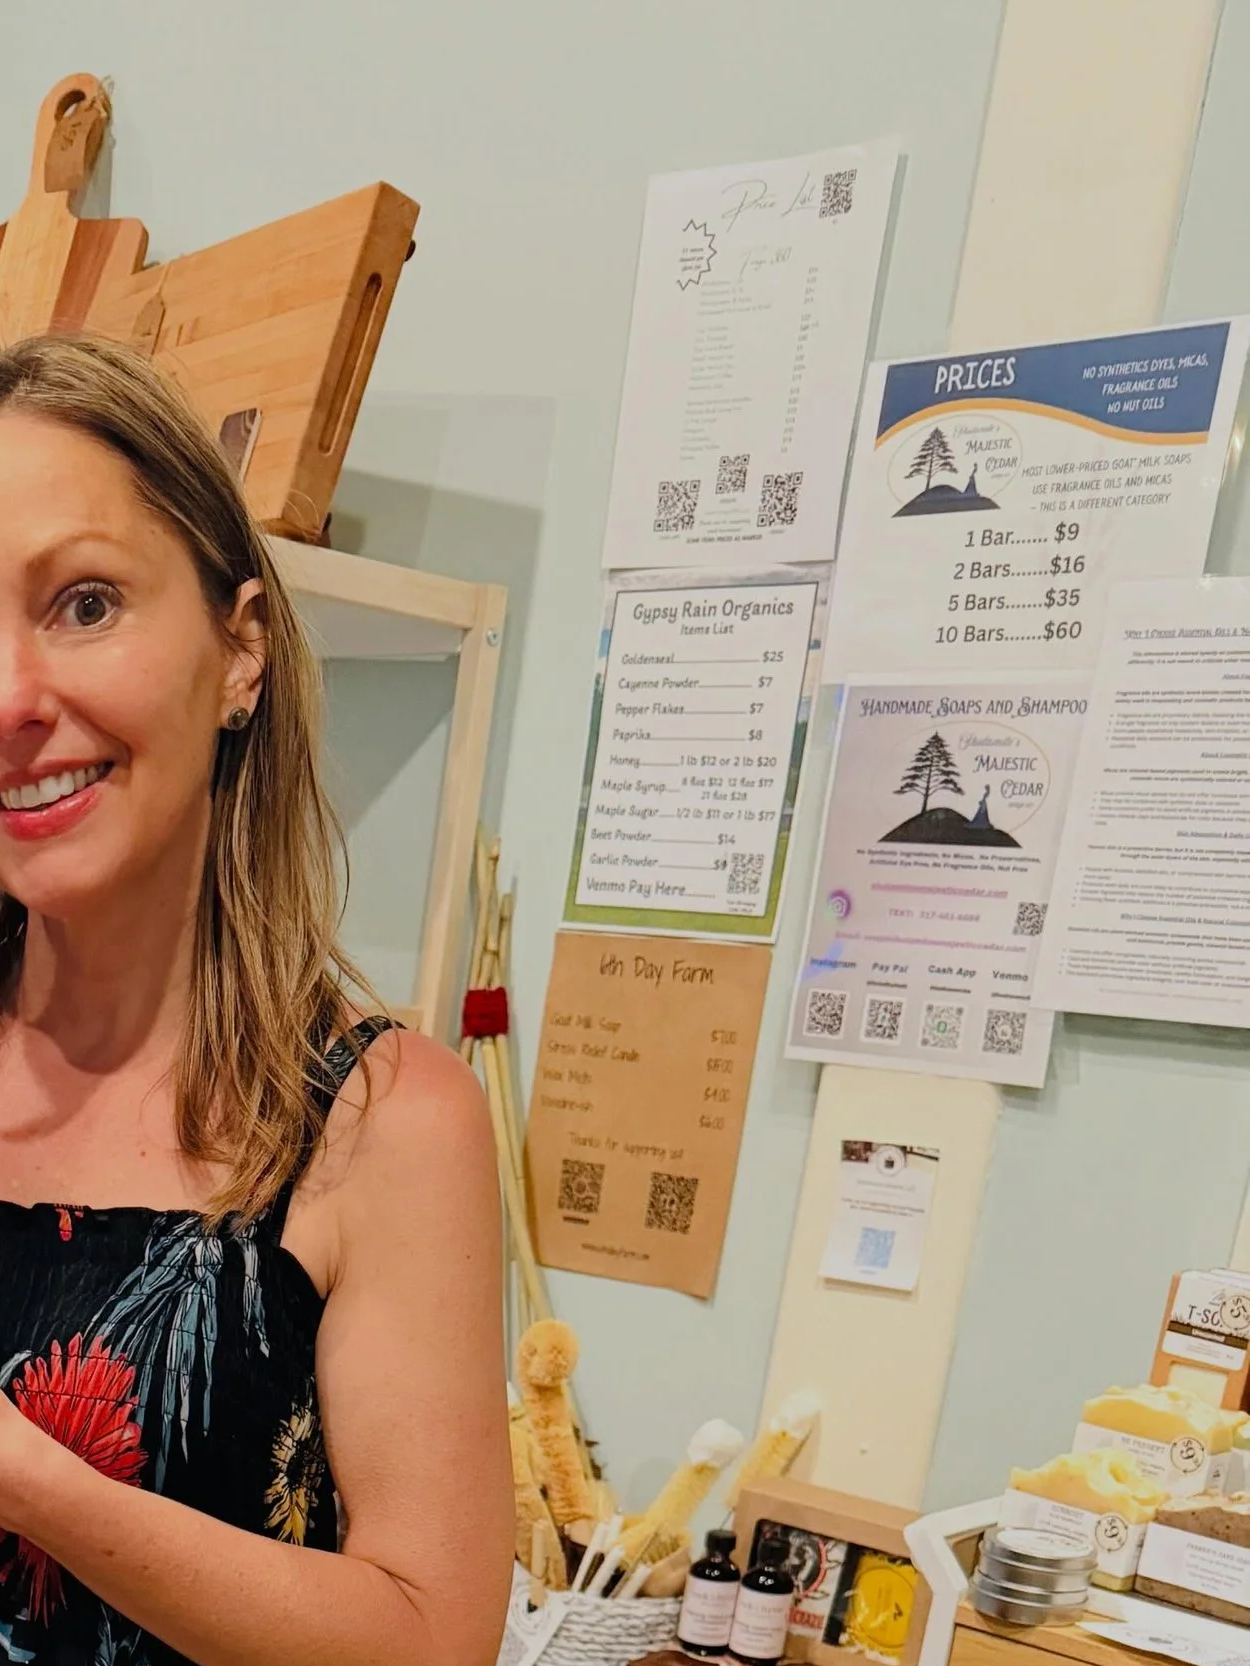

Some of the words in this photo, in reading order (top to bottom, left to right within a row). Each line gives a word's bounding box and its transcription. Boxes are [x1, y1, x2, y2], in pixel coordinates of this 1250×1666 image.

[721, 179, 777, 233] Price
[934, 356, 1017, 394] PRICES
[1082, 367, 1096, 379] NO
[1097, 360, 1149, 378] SYNTHETICS
[1102, 379, 1155, 396] FRAGRANCE
[1157, 375, 1179, 389] OILS
[1107, 402, 1121, 414] NO
[1122, 400, 1141, 412] NUT
[1141, 396, 1165, 411] OILS
[964, 438, 1013, 455] MAJESTIC
[985, 456, 1019, 473] CEDAR
[1022, 466, 1043, 478] MOST
[1045, 459, 1110, 477] LOWER-PRICED
[1138, 455, 1162, 469] MILK
[1163, 453, 1192, 466] SOAPS
[1032, 485, 1048, 495] USE
[1050, 480, 1102, 494] FRAGRANCE
[1103, 478, 1122, 489] OILS
[1124, 476, 1144, 487] AND
[1145, 474, 1173, 486] MICAS
[1039, 501, 1057, 513] THIS
[1069, 501, 1075, 510] A
[1077, 496, 1125, 510] DIFFERENT
[964, 531, 976, 548] 1
[1053, 521, 1080, 544] $9
[953, 562, 965, 580] 2
[633, 602, 678, 624] Gypsy
[681, 599, 717, 618] Rain
[721, 597, 794, 622] Organics
[947, 594, 960, 612] 5
[680, 624, 711, 636] Items
[712, 622, 735, 635] List
[934, 626, 959, 644] 10
[621, 653, 675, 666] Goldenseal
[762, 650, 784, 664] $25
[617, 677, 659, 693] Cayenne
[661, 676, 700, 690] Powder
[757, 676, 773, 689] $7
[615, 703, 650, 718] Pepper
[651, 702, 685, 715] Flakes
[749, 702, 765, 715] $7
[859, 698, 932, 718] HANDMADE
[930, 697, 982, 718] SOAPS
[986, 699, 1014, 715] AND
[612, 728, 651, 742] Paprika
[748, 729, 763, 742] $8
[609, 754, 641, 770] Honey
[700, 755, 717, 768] $12
[719, 757, 731, 767] or
[733, 756, 740, 767] 2
[757, 756, 777, 768] $20
[972, 754, 1038, 773] MAJESTIC
[601, 779, 633, 794] Maple
[635, 780, 667, 795] Syrup
[1000, 779, 1044, 799] CEDAR
[594, 804, 627, 818] Maple
[628, 804, 659, 819] Sugar
[722, 811, 735, 821] or
[590, 828, 612, 841] Beet
[613, 829, 652, 842] Powder
[717, 833, 736, 845] $14
[590, 853, 619, 866] Garlic
[620, 853, 658, 867] Powder
[586, 877, 626, 893] Venmo
[628, 879, 651, 898] Pay
[654, 882, 686, 897] Here
[599, 952, 623, 977] 6th
[634, 955, 664, 987] Day
[672, 959, 715, 985] Farm
[871, 962, 889, 974] Pay
[890, 963, 909, 974] Pal
[927, 965, 954, 976] Cash
[956, 967, 977, 979] App
[992, 969, 1029, 982] Venmo
